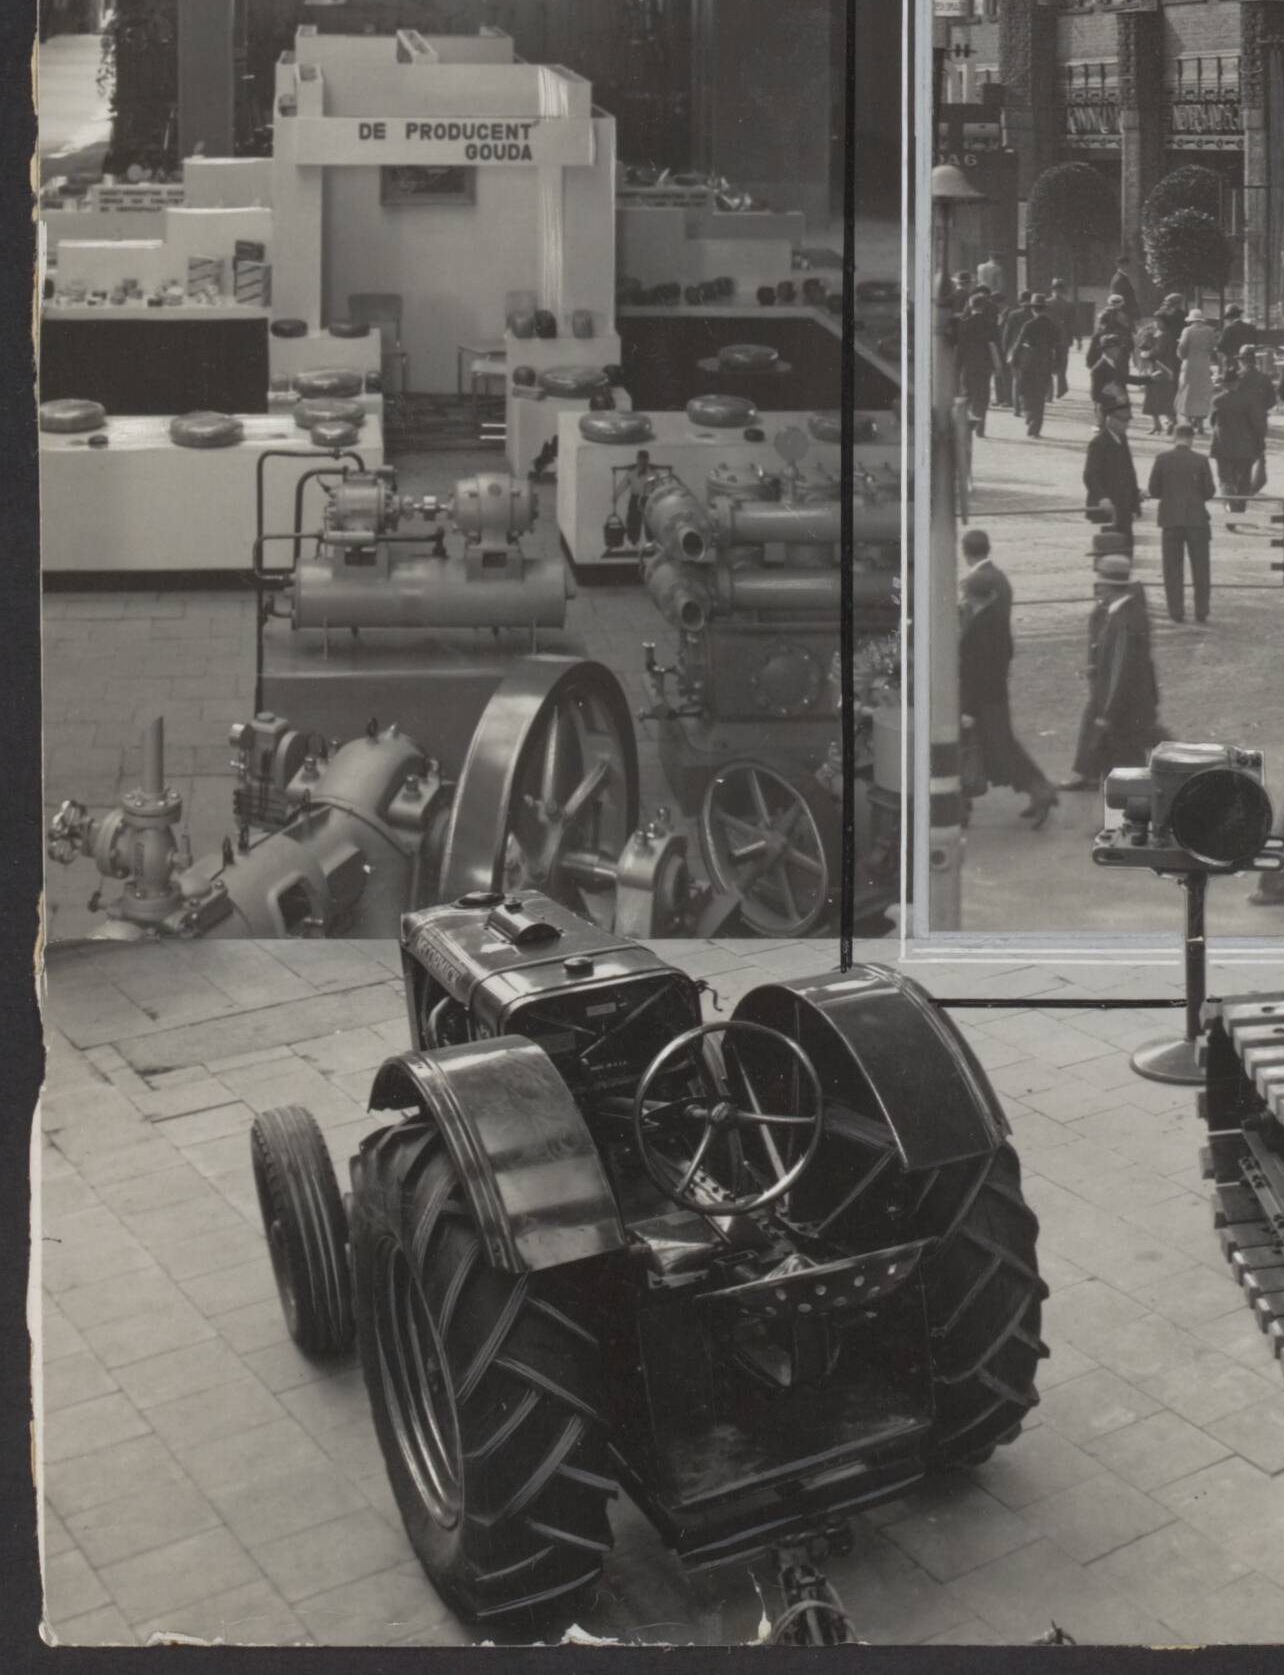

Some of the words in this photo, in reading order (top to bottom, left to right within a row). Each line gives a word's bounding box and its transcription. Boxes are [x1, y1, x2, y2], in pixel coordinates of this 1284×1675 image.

[359, 121, 387, 141] DE
[405, 121, 532, 141] PRODUCENT
[465, 143, 532, 161] GOUDA
